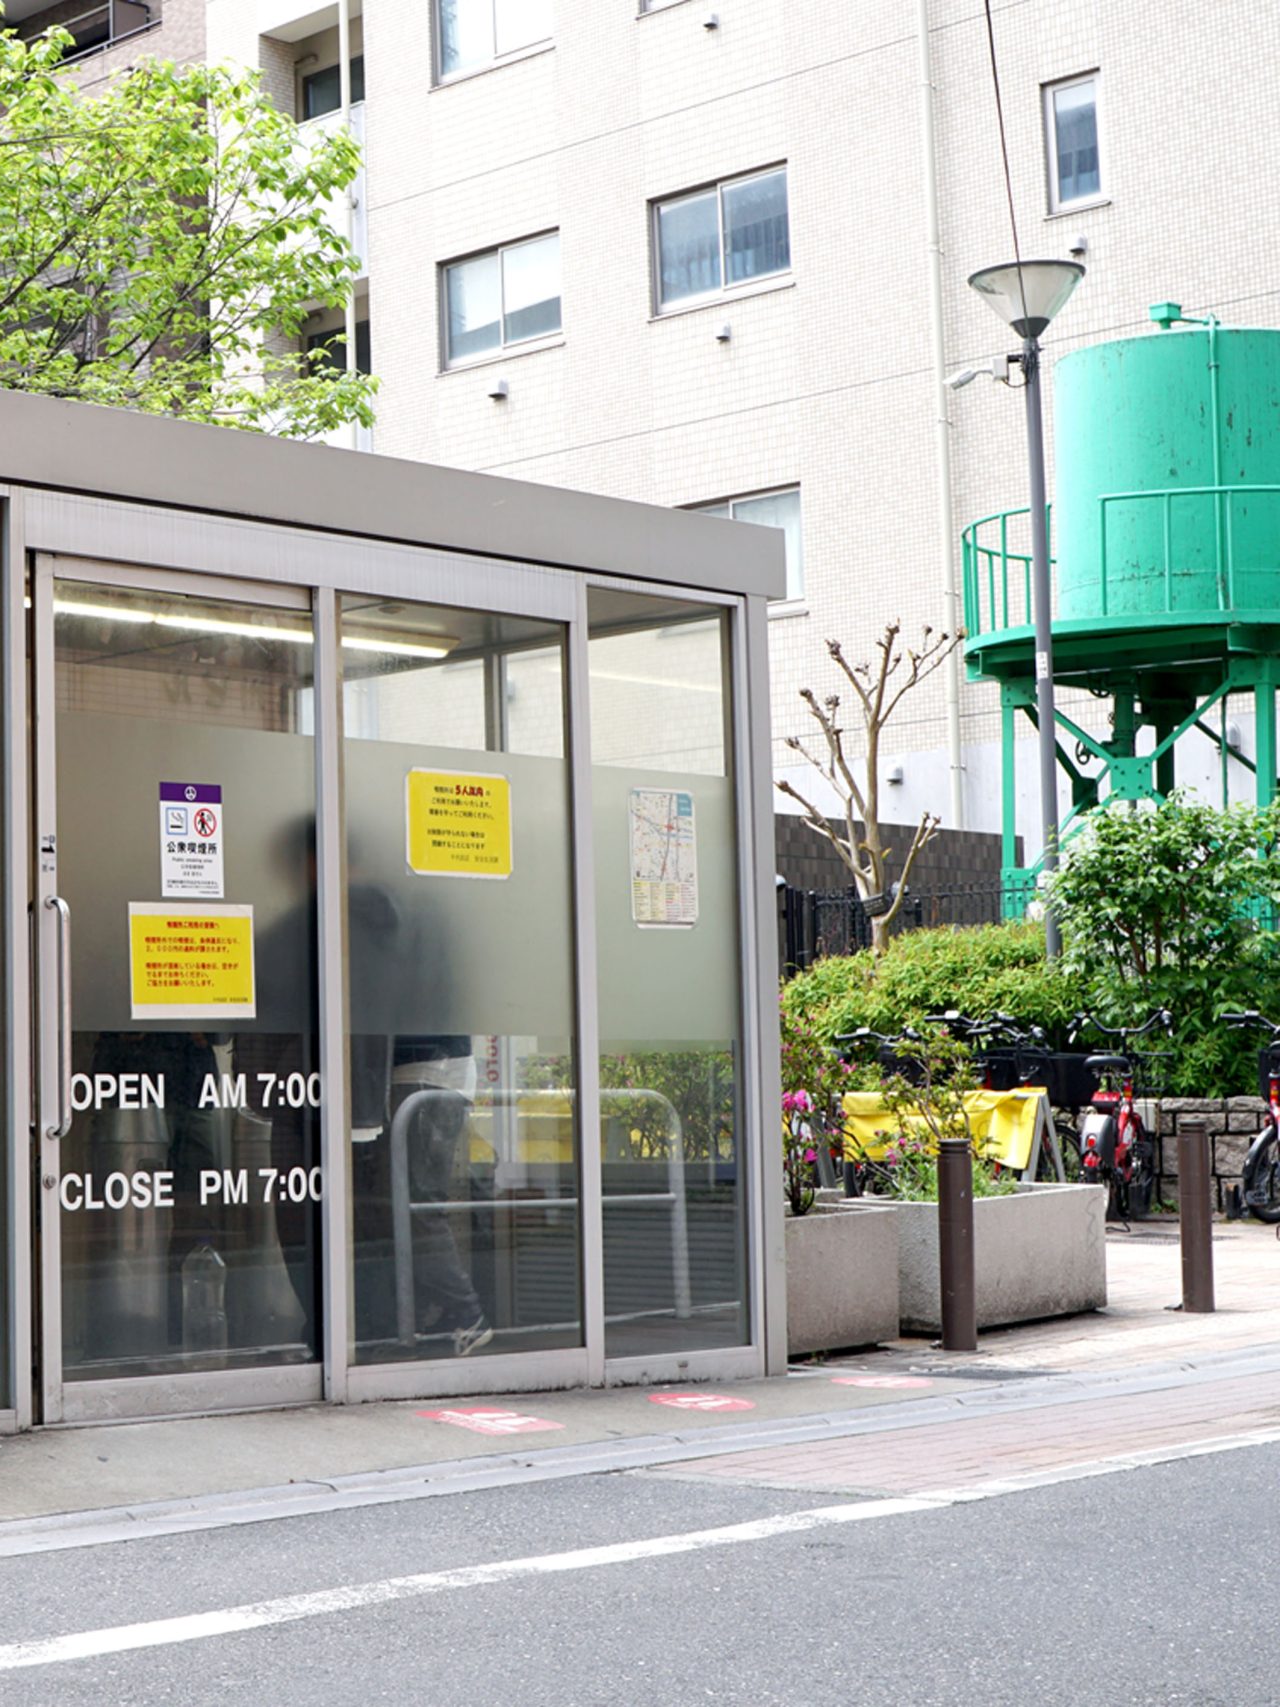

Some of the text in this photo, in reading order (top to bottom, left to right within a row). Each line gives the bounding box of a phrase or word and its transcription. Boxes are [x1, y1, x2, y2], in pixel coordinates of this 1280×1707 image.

[70, 1073, 165, 1110] OPEN
[198, 1073, 247, 1109] AM
[60, 1171, 174, 1211] CLOSE
[200, 1169, 248, 1206] PM
